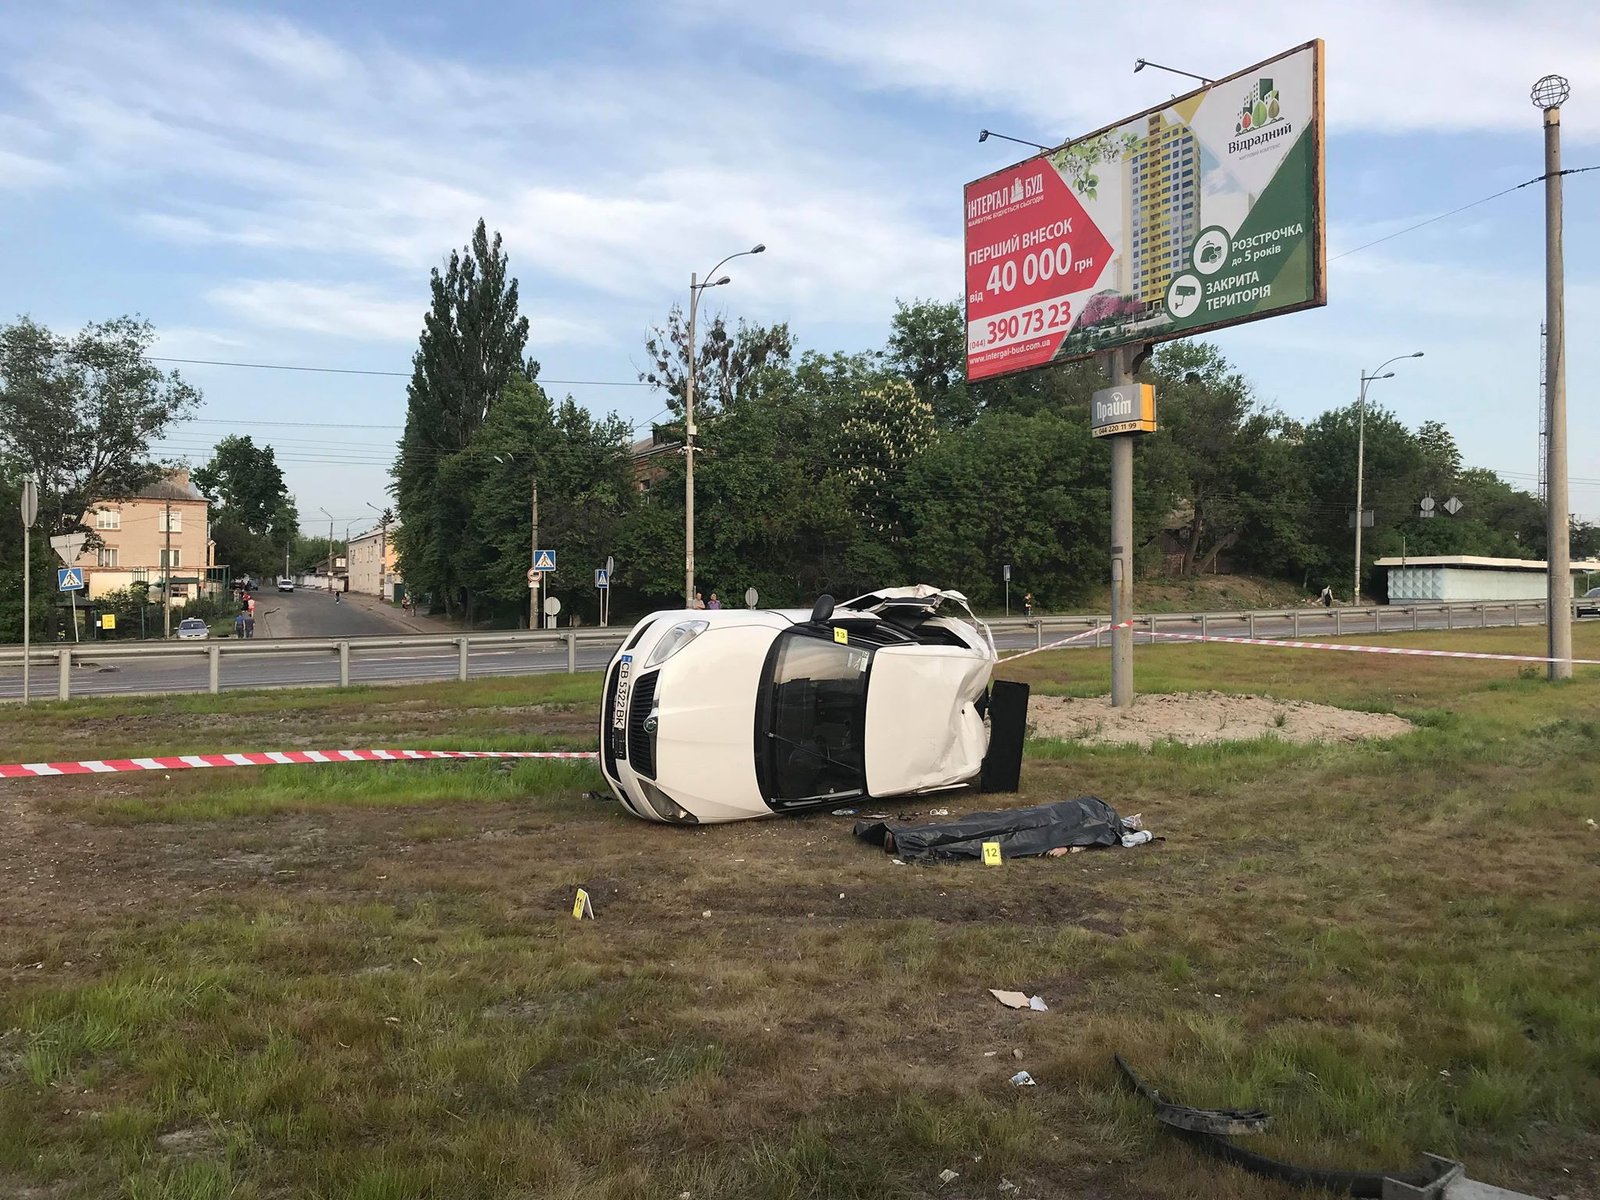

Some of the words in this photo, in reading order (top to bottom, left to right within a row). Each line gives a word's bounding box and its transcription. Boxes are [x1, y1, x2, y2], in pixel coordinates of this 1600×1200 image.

[1228, 122, 1292, 154] Відрадний
[1025, 174, 1044, 197] БУД
[969, 233, 1020, 266] ПЕРШИЙ
[1022, 217, 1073, 249] ВНЕСОК
[1232, 223, 1303, 252] РОЗСТРОЧКА
[1231, 257, 1242, 267] до
[1244, 251, 1251, 262] 5
[1253, 244, 1281, 262] років
[969, 291, 984, 303] від
[986, 259, 1017, 296] 40
[1023, 242, 1073, 286] 000
[1074, 256, 1093, 274] грн
[1206, 270, 1260, 295] ЗАКРИТА
[1206, 285, 1271, 311] ТЕРИТОРІЯ
[969, 338, 986, 350] (044)
[987, 314, 1019, 345] 390
[1022, 307, 1044, 336] 73
[1048, 301, 1071, 329] 23
[969, 339, 1051, 365] www.intergal-bud.com.ua
[1108, 425, 1119, 433] 220
[836, 631, 845, 639] 13
[618, 682, 627, 707] 5322
[985, 848, 998, 857] 12
